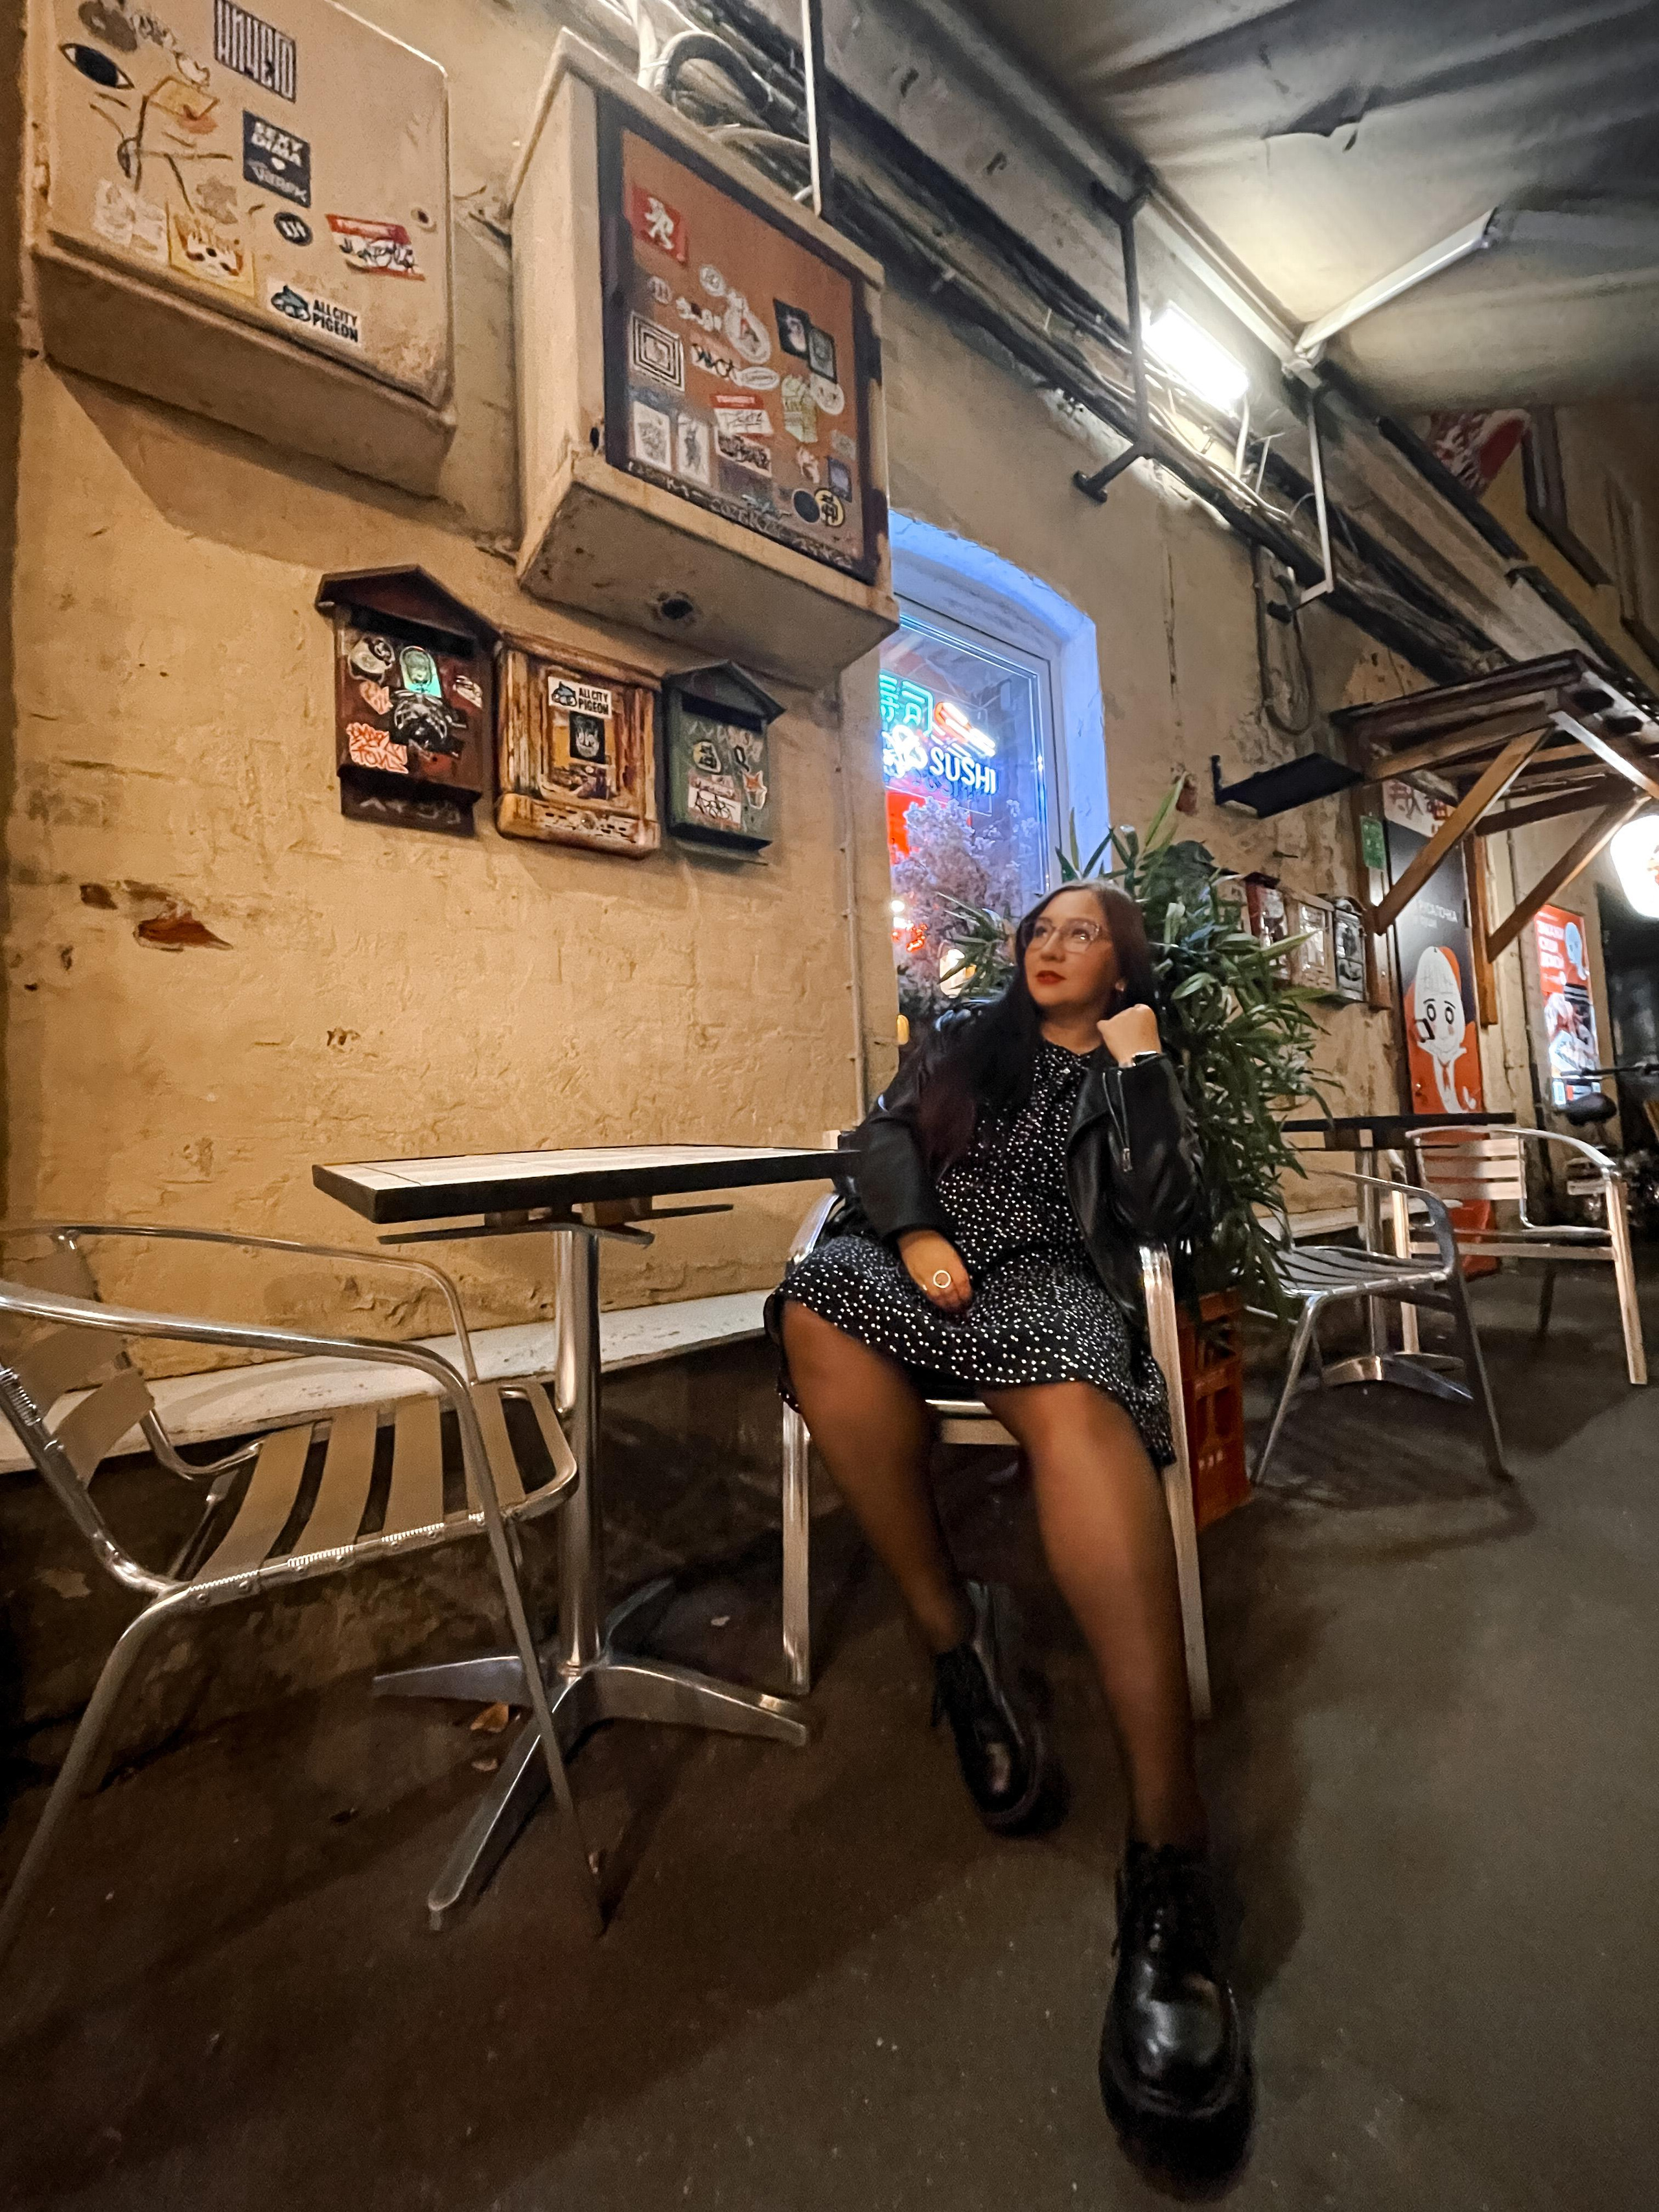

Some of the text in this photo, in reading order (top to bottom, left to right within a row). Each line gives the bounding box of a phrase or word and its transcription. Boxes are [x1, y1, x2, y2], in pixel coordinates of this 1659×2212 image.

[313, 299, 358, 326] ALL CITY
[312, 312, 358, 343] PIGEON
[578, 697, 609, 716] PIGEON
[579, 688, 608, 703] ALL CITY
[929, 746, 996, 795] SUSHI
